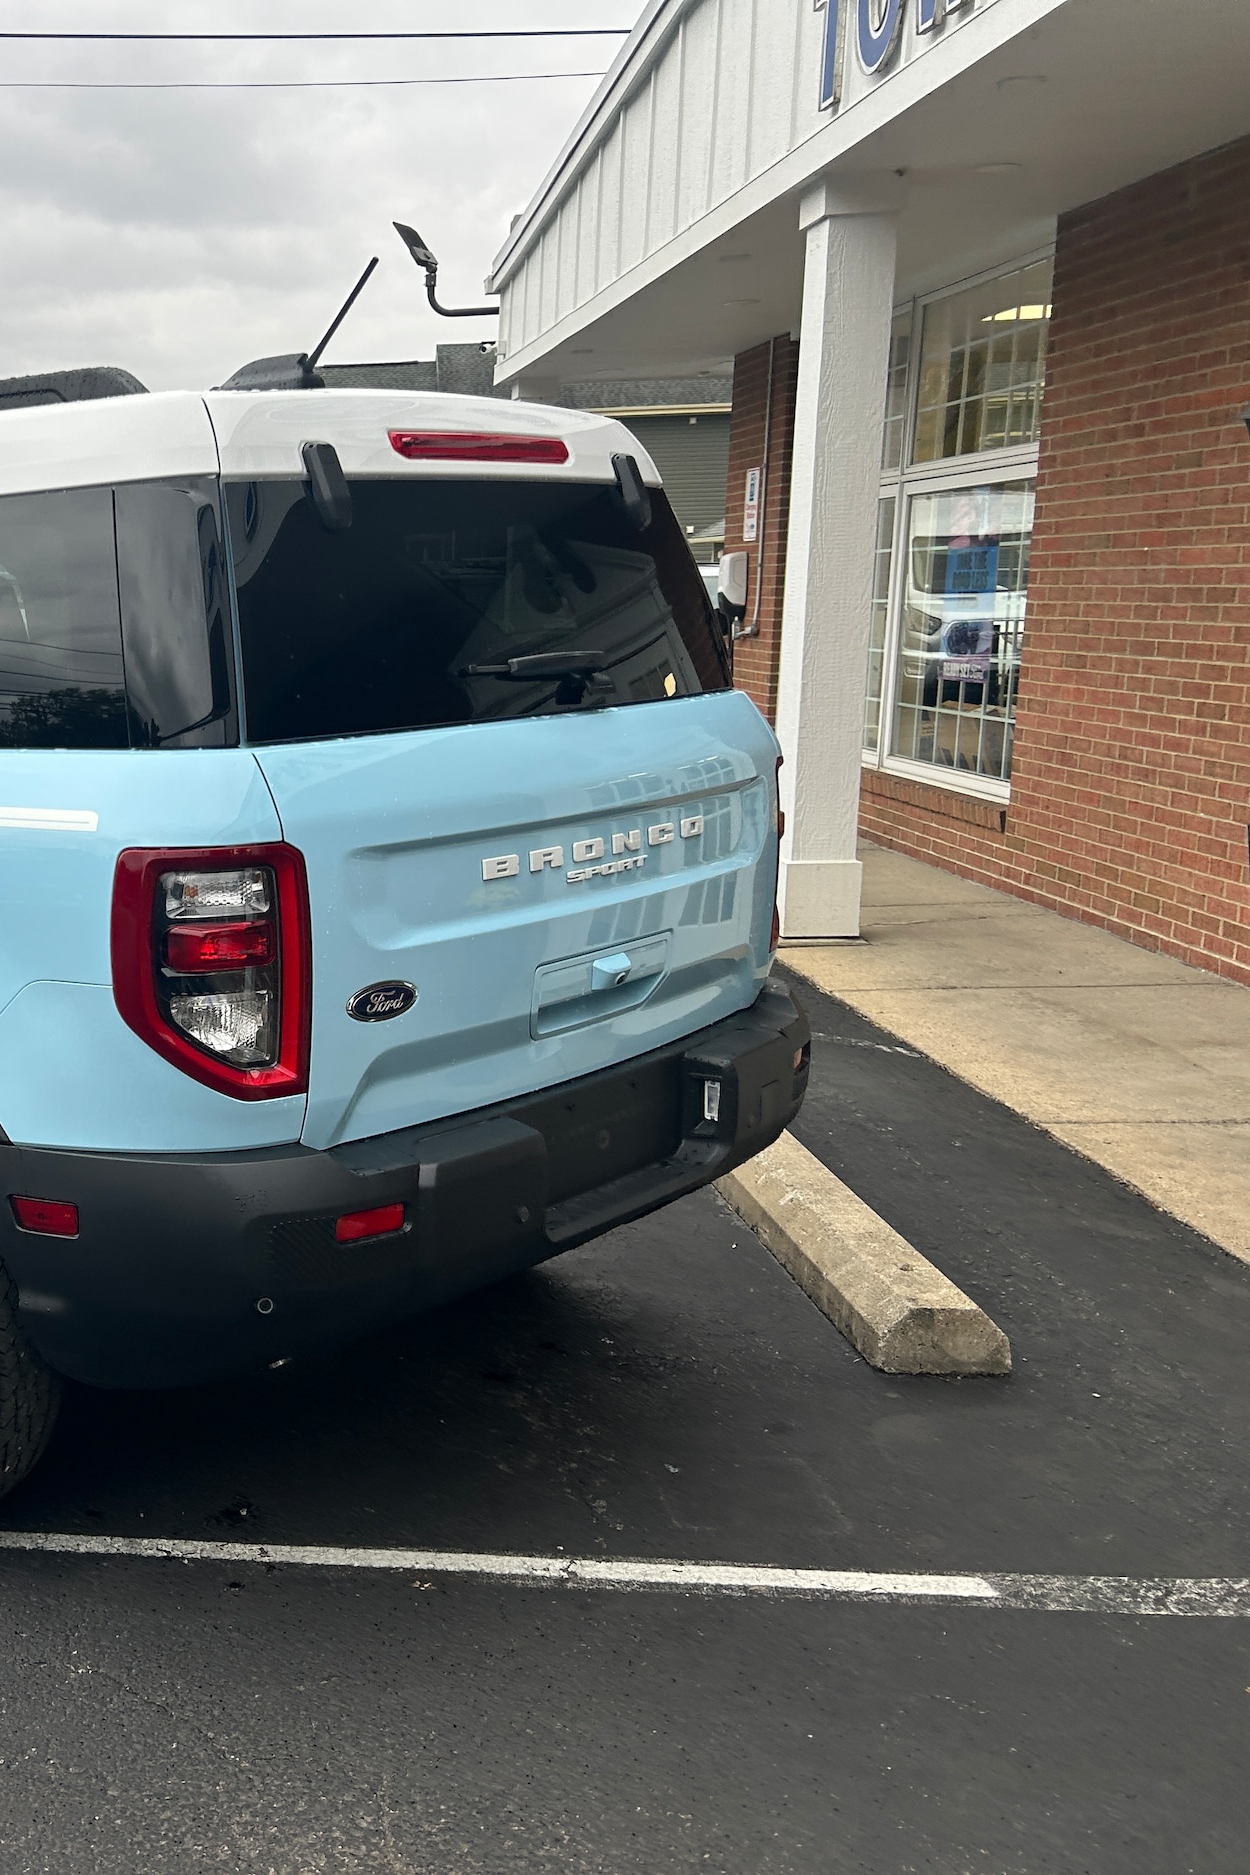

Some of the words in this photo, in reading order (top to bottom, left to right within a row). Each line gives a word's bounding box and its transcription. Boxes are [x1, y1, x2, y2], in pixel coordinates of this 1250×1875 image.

[481, 815, 704, 881] BRONCO
[566, 854, 648, 883] SPORT
[366, 989, 405, 1013] Ford
